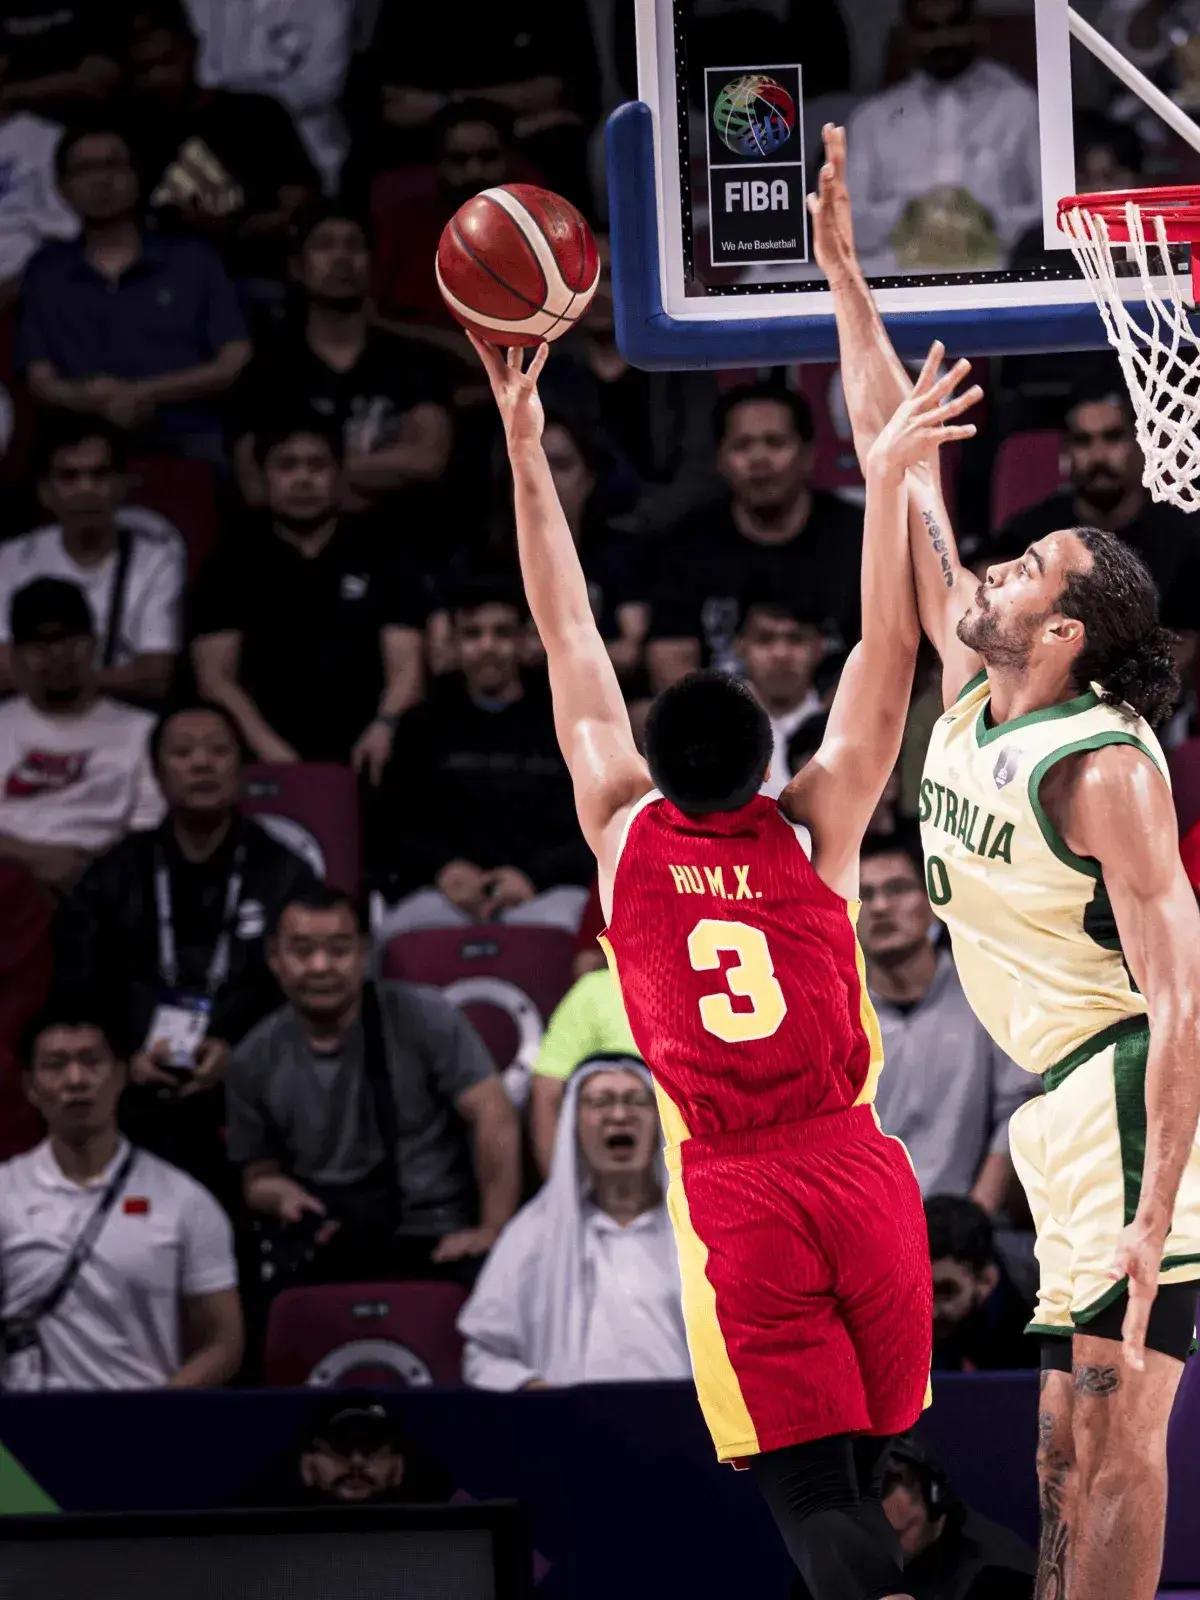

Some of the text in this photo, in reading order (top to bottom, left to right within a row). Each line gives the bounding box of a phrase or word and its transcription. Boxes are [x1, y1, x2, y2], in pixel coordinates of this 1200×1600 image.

[725, 179, 789, 212] FIBA
[721, 238, 797, 251] We Are Basketball
[668, 864, 763, 900] HU M.X.
[686, 918, 788, 1044] 3
